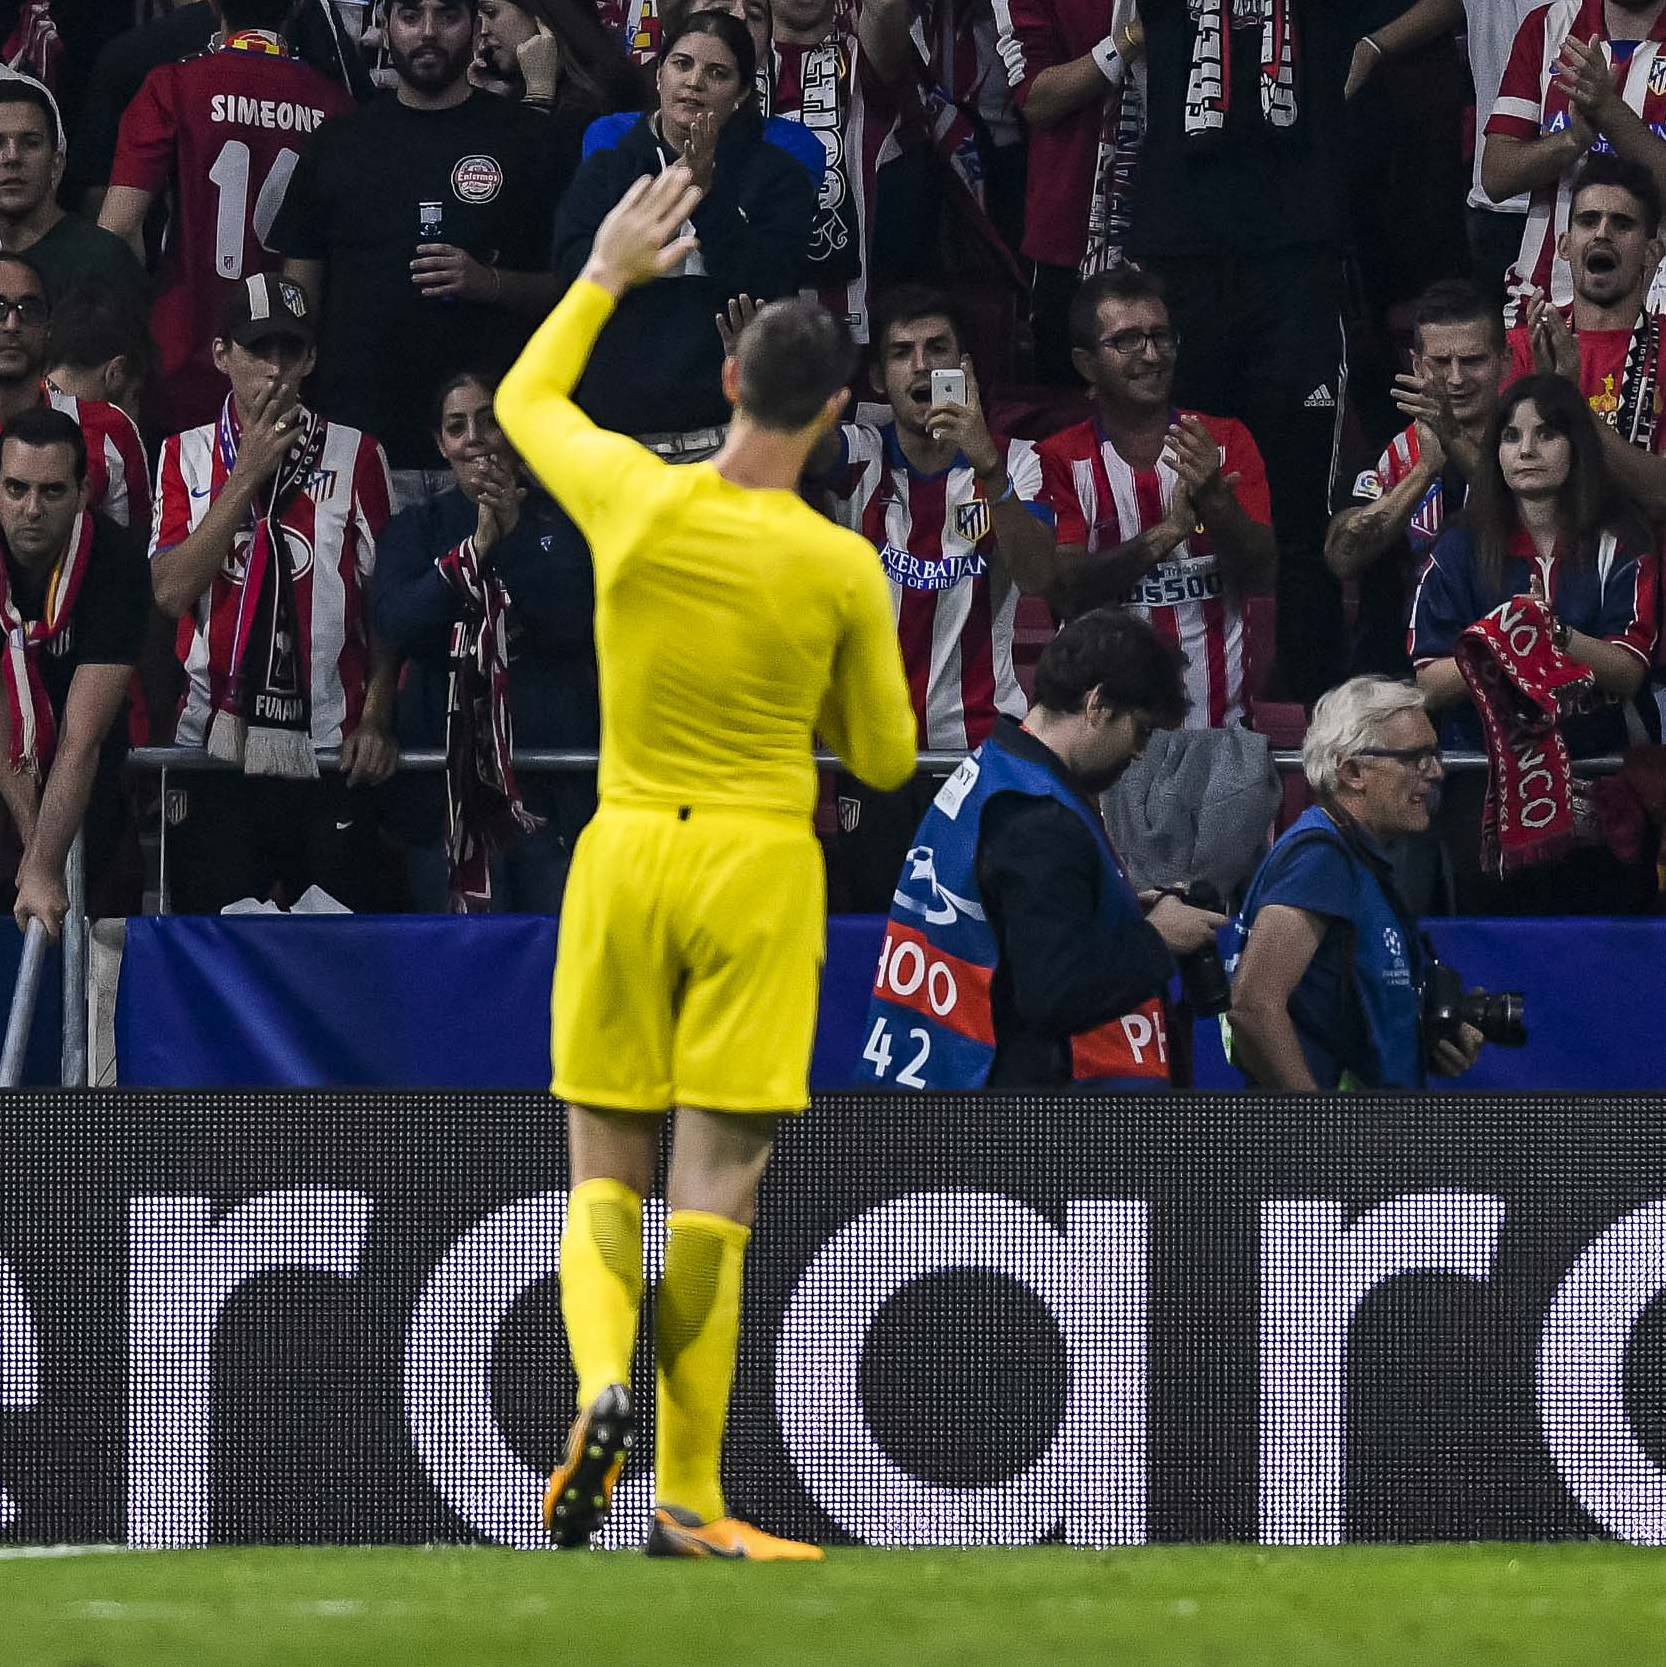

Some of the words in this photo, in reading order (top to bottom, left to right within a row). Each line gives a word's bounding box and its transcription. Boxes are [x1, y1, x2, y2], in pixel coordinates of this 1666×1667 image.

[880, 542, 989, 579] AZERBAIJAN
[917, 574, 934, 589] OF
[862, 1015, 931, 1090] 42
